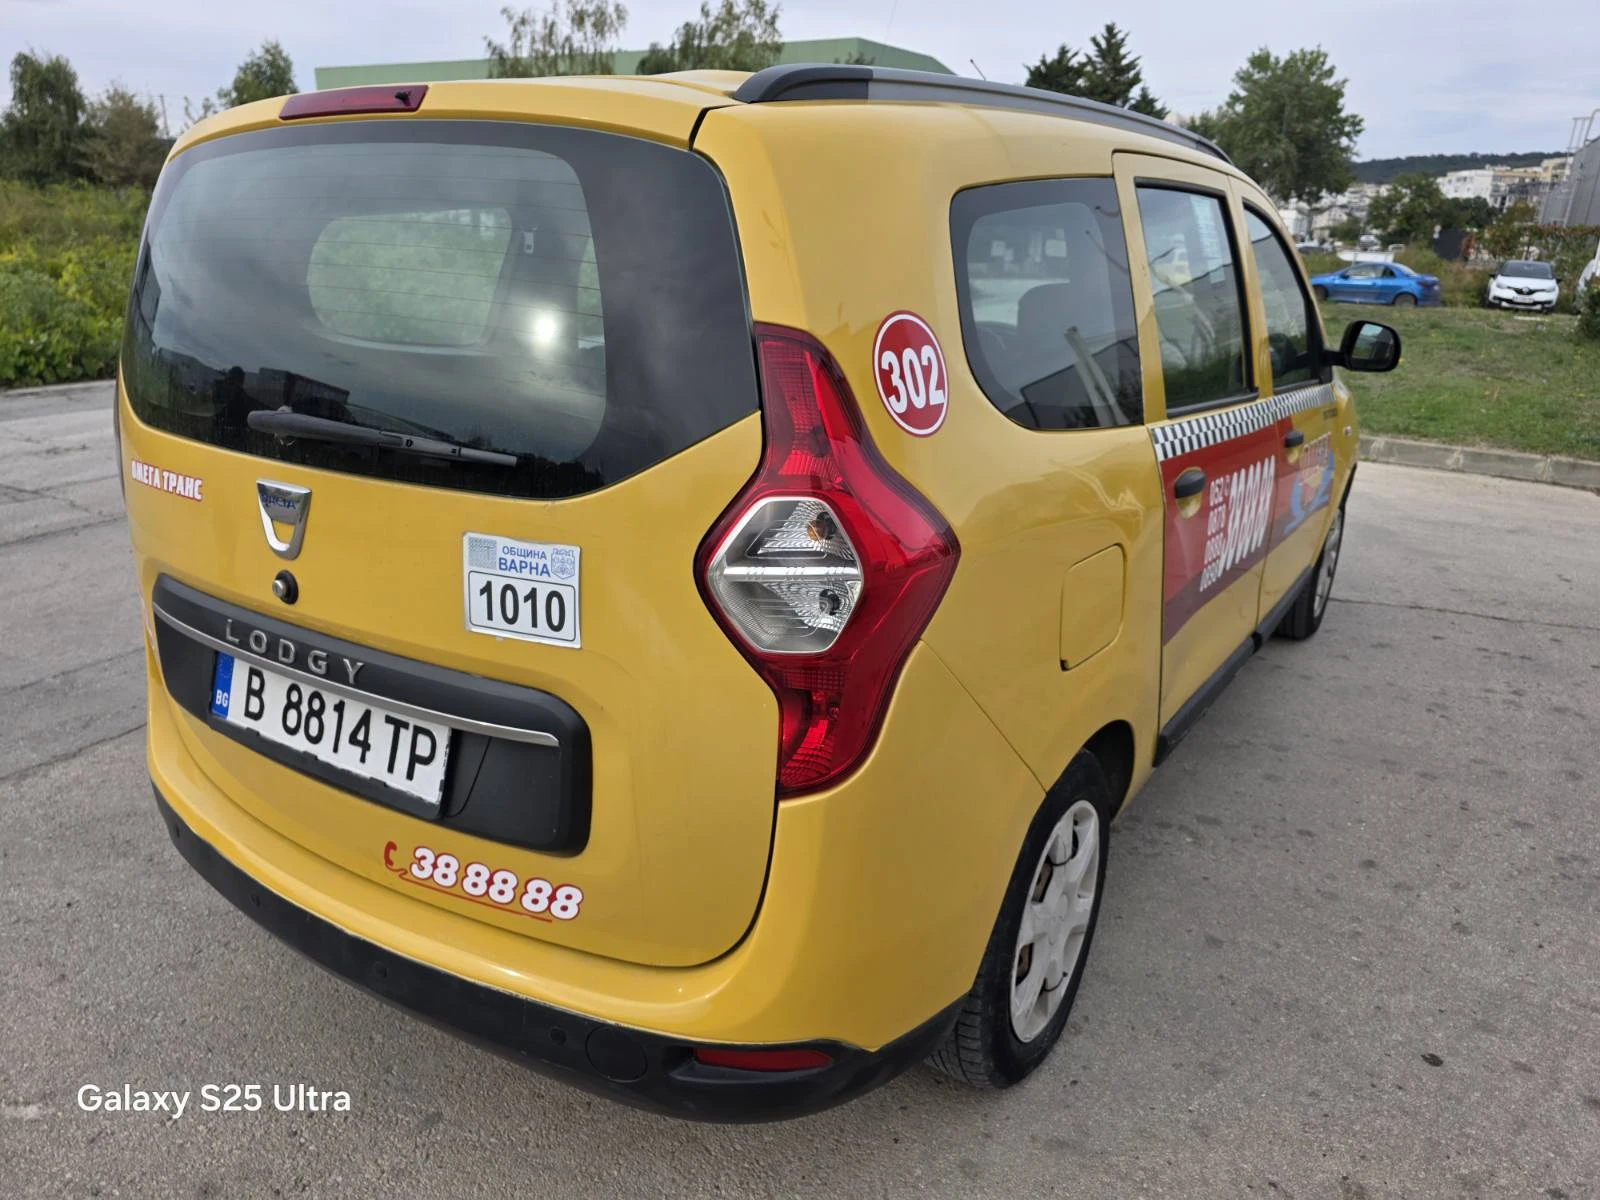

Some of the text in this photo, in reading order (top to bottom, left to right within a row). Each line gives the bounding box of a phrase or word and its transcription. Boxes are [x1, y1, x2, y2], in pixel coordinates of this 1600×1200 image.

[881, 345, 945, 414] 302
[131, 459, 204, 502] ОМЕГА ТРАНС
[498, 557, 551, 578] ВАРНА
[502, 545, 547, 560] ОБЩИНА
[479, 580, 566, 633] 1010
[225, 618, 365, 685] LODGY
[215, 688, 229, 706] BG
[281, 683, 373, 764] 8814
[410, 846, 584, 920] 38 88 88
